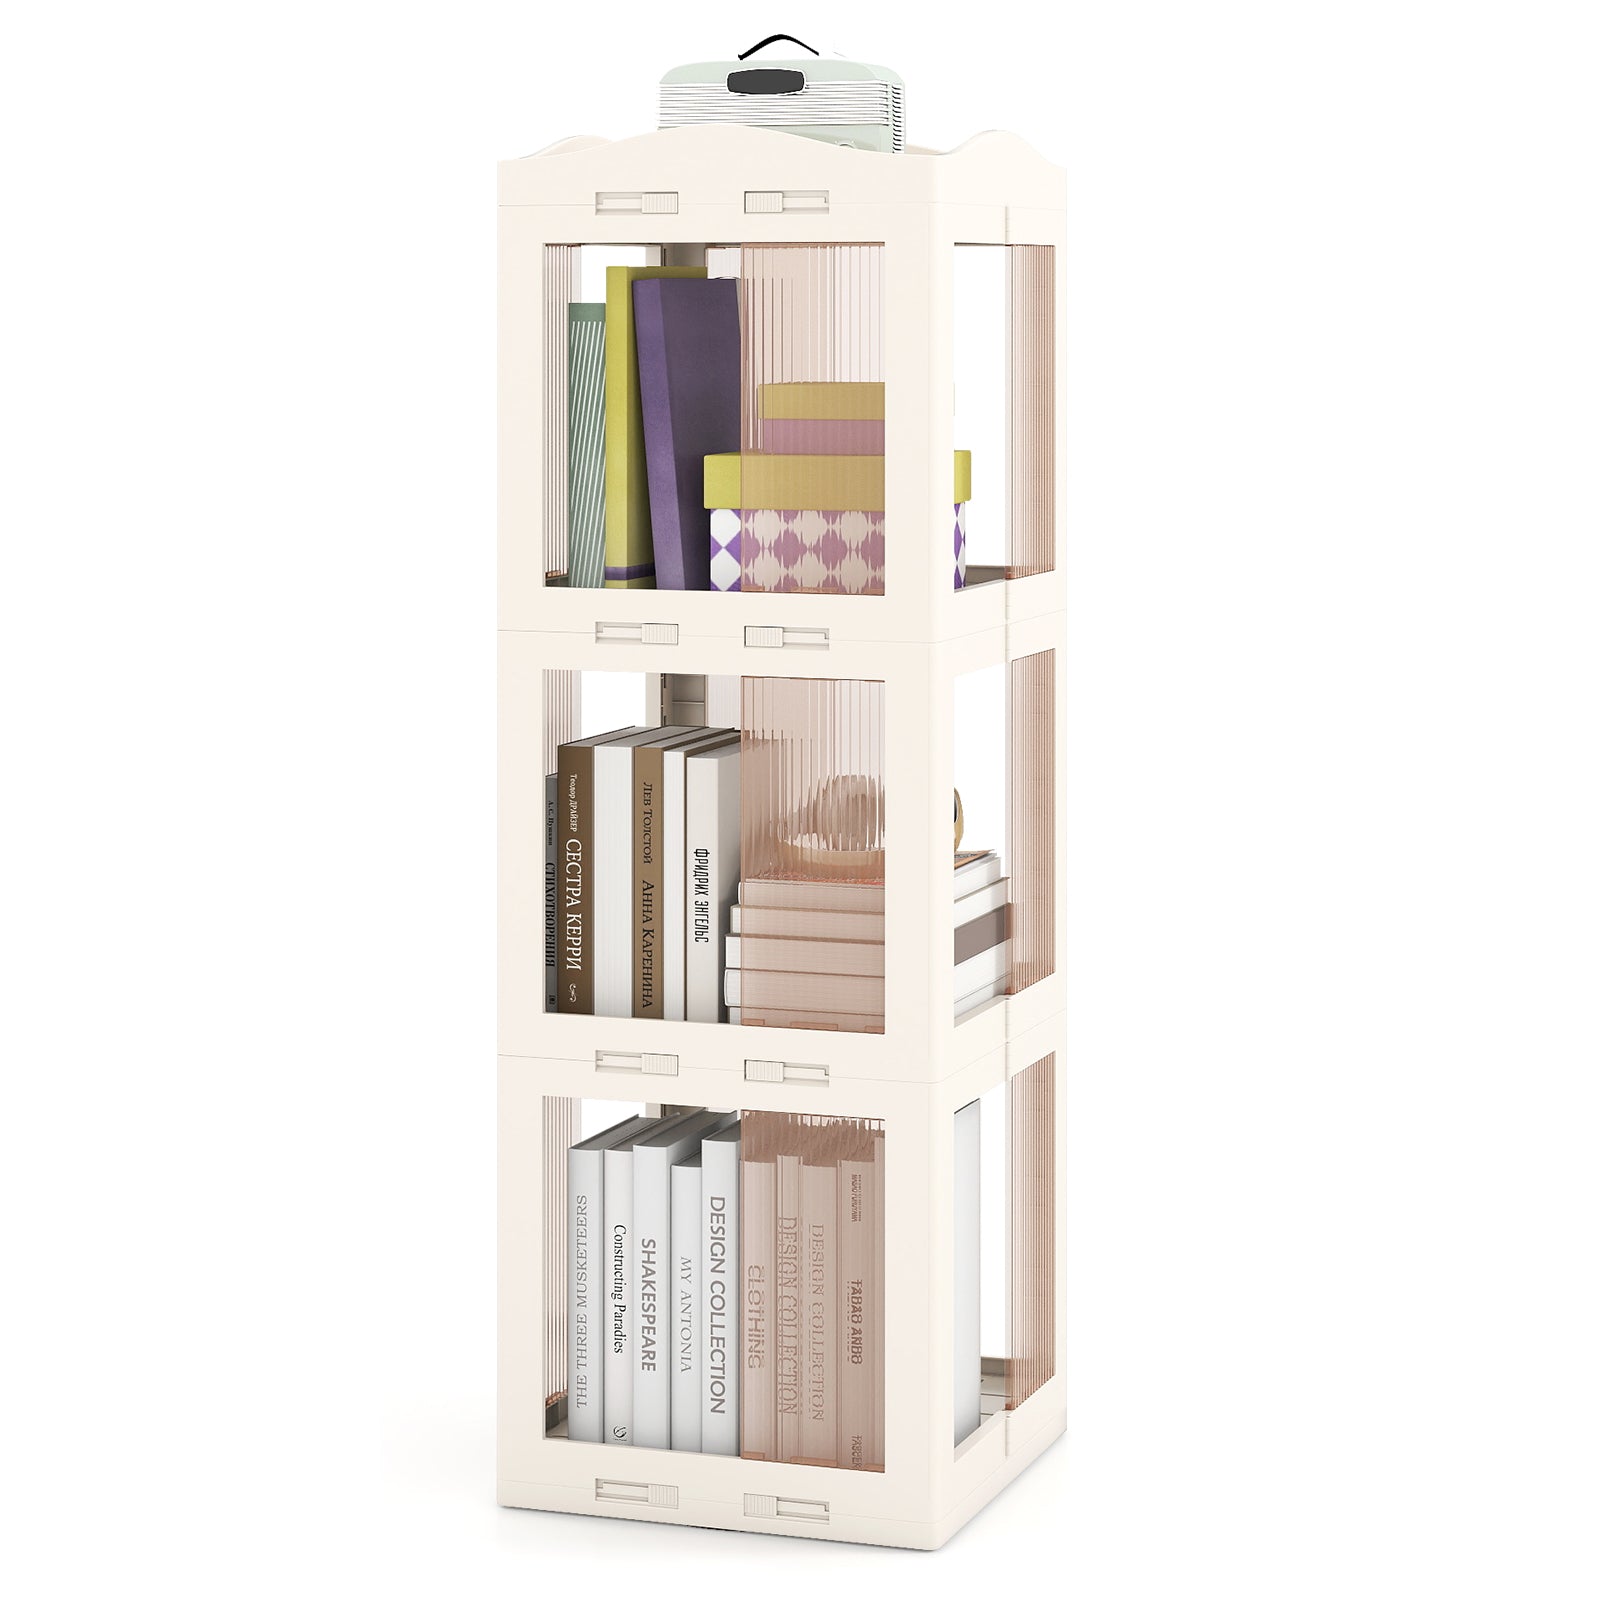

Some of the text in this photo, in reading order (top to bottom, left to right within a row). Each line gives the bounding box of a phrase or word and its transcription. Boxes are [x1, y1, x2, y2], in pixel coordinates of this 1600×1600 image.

[569, 774, 579, 832] Теодор ДРАЙЗЕР
[643, 782, 653, 864] ЛЕВ ТОЛСТОЙ
[545, 862, 556, 967] СТИХОТВОРЕНИЯ
[565, 838, 582, 971] СЕСТРА КЕРРИ
[642, 880, 655, 1009] АННА КАРЕНИНА
[693, 848, 710, 943] ФРИДРИХ ЭНГЕЛЬС
[576, 1195, 587, 1409] THE THREE MUSKETEERS
[611, 1224, 627, 1354] Constructing Paradies
[641, 1238, 656, 1372] SHAKESPEARE
[680, 1256, 692, 1373] MY ANTONIA
[710, 1196, 726, 1414] DESIGN COLLECTION
[748, 1265, 764, 1369] CLOTHING
